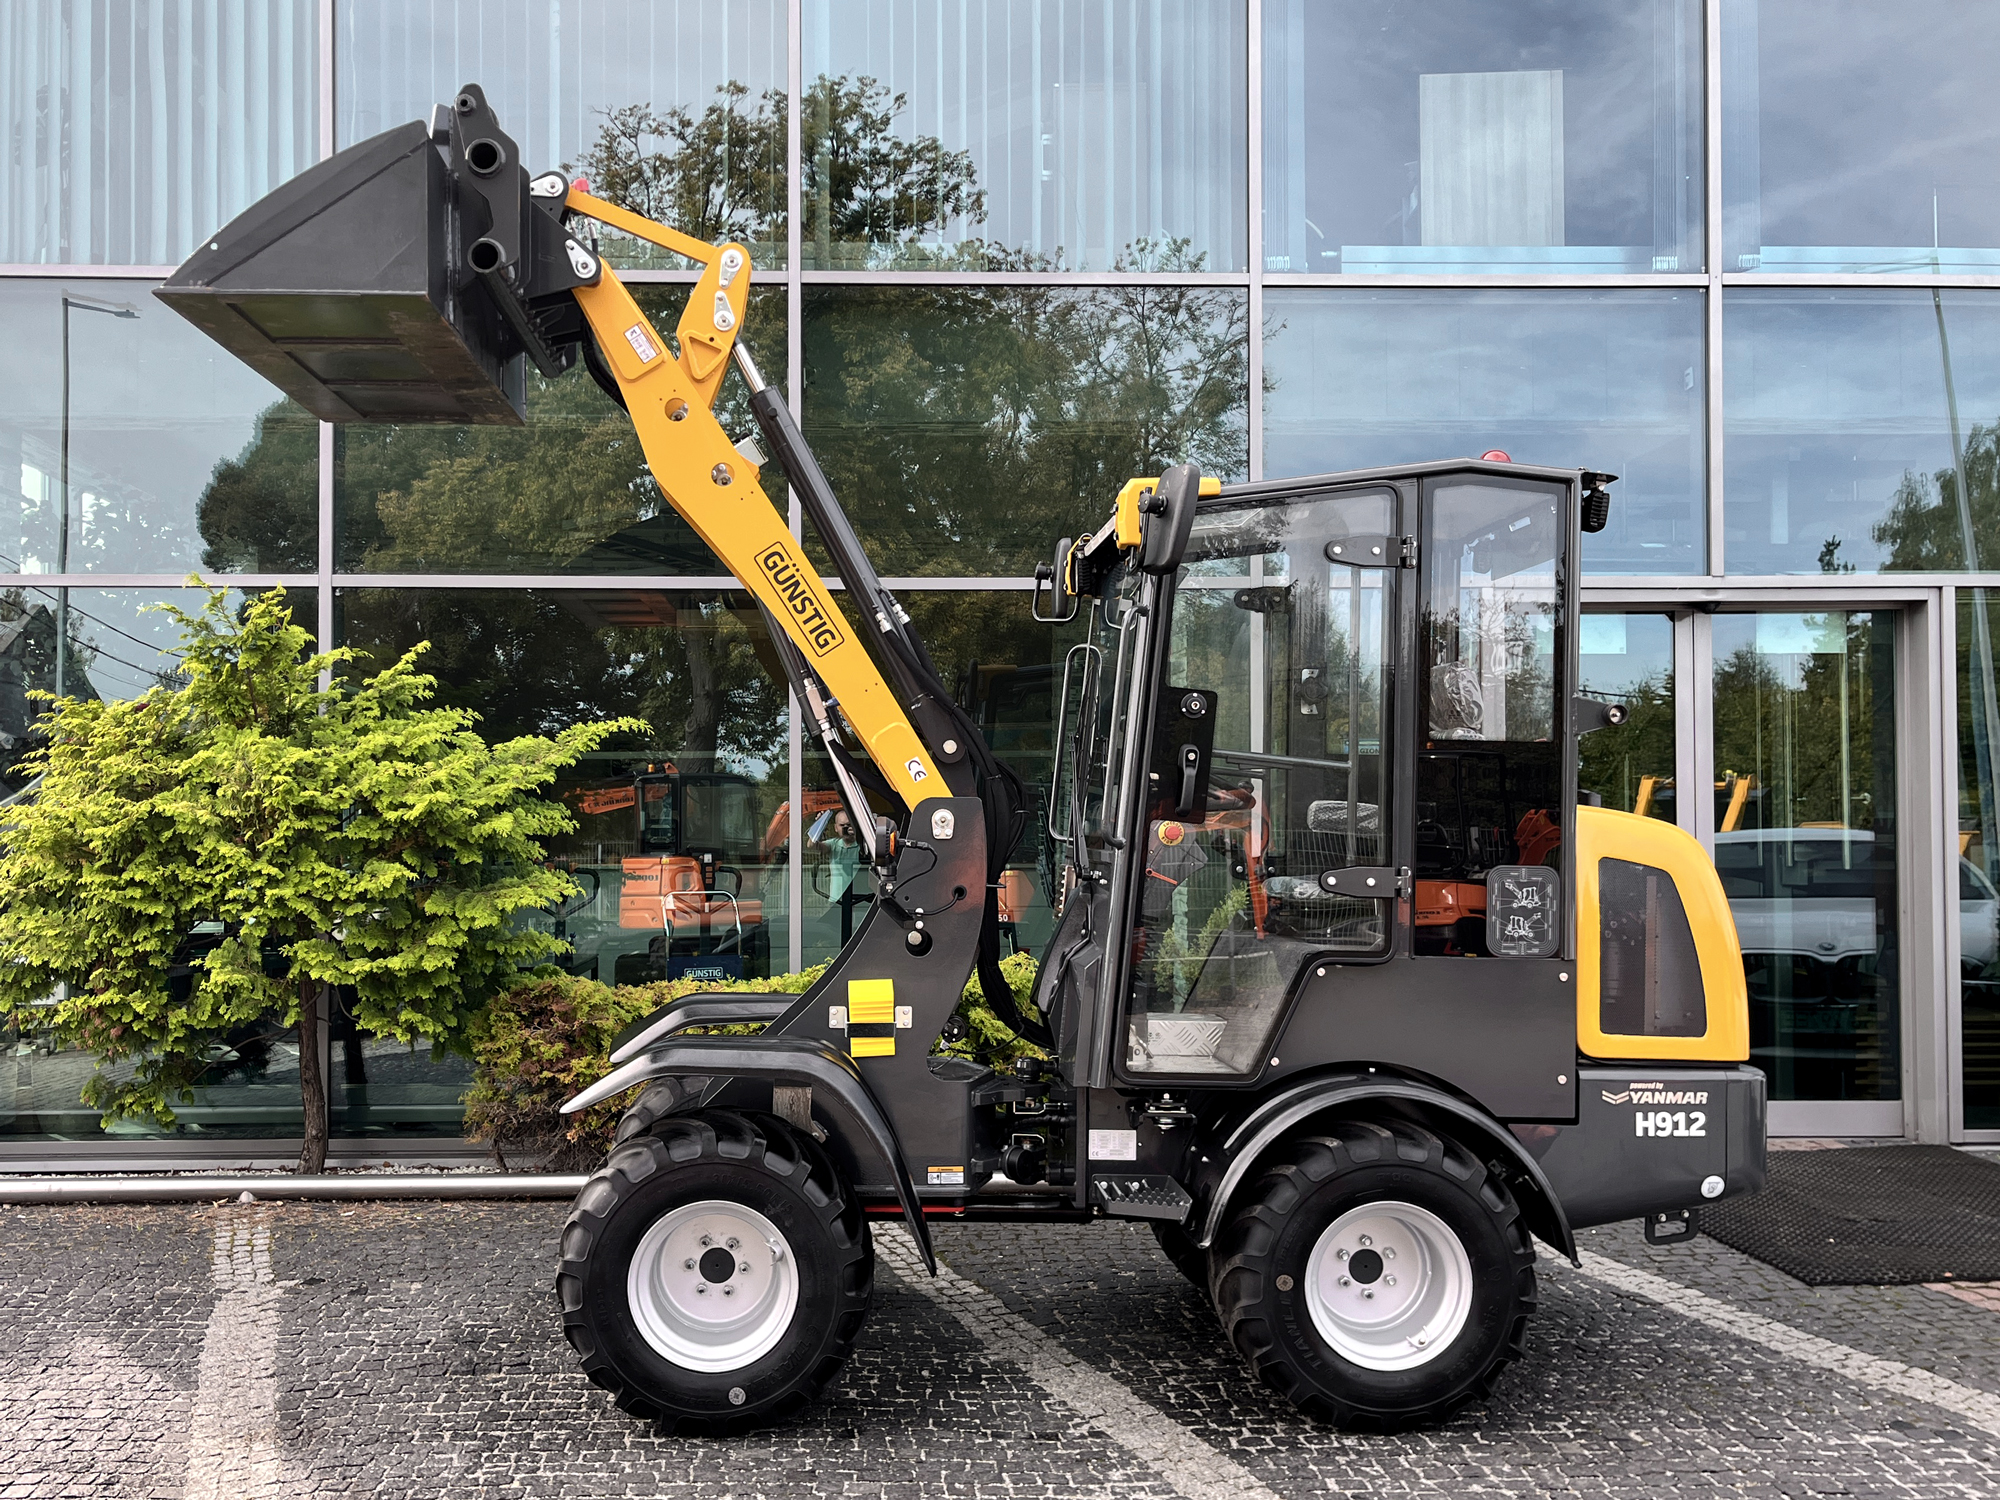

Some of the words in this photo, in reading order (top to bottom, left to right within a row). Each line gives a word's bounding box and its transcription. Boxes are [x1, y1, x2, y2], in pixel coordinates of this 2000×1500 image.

[763, 551, 836, 649] GÜNSTIG
[908, 760, 927, 782] CE
[1629, 1091, 1708, 1104] YANMAR
[1635, 1111, 1706, 1137] H912
